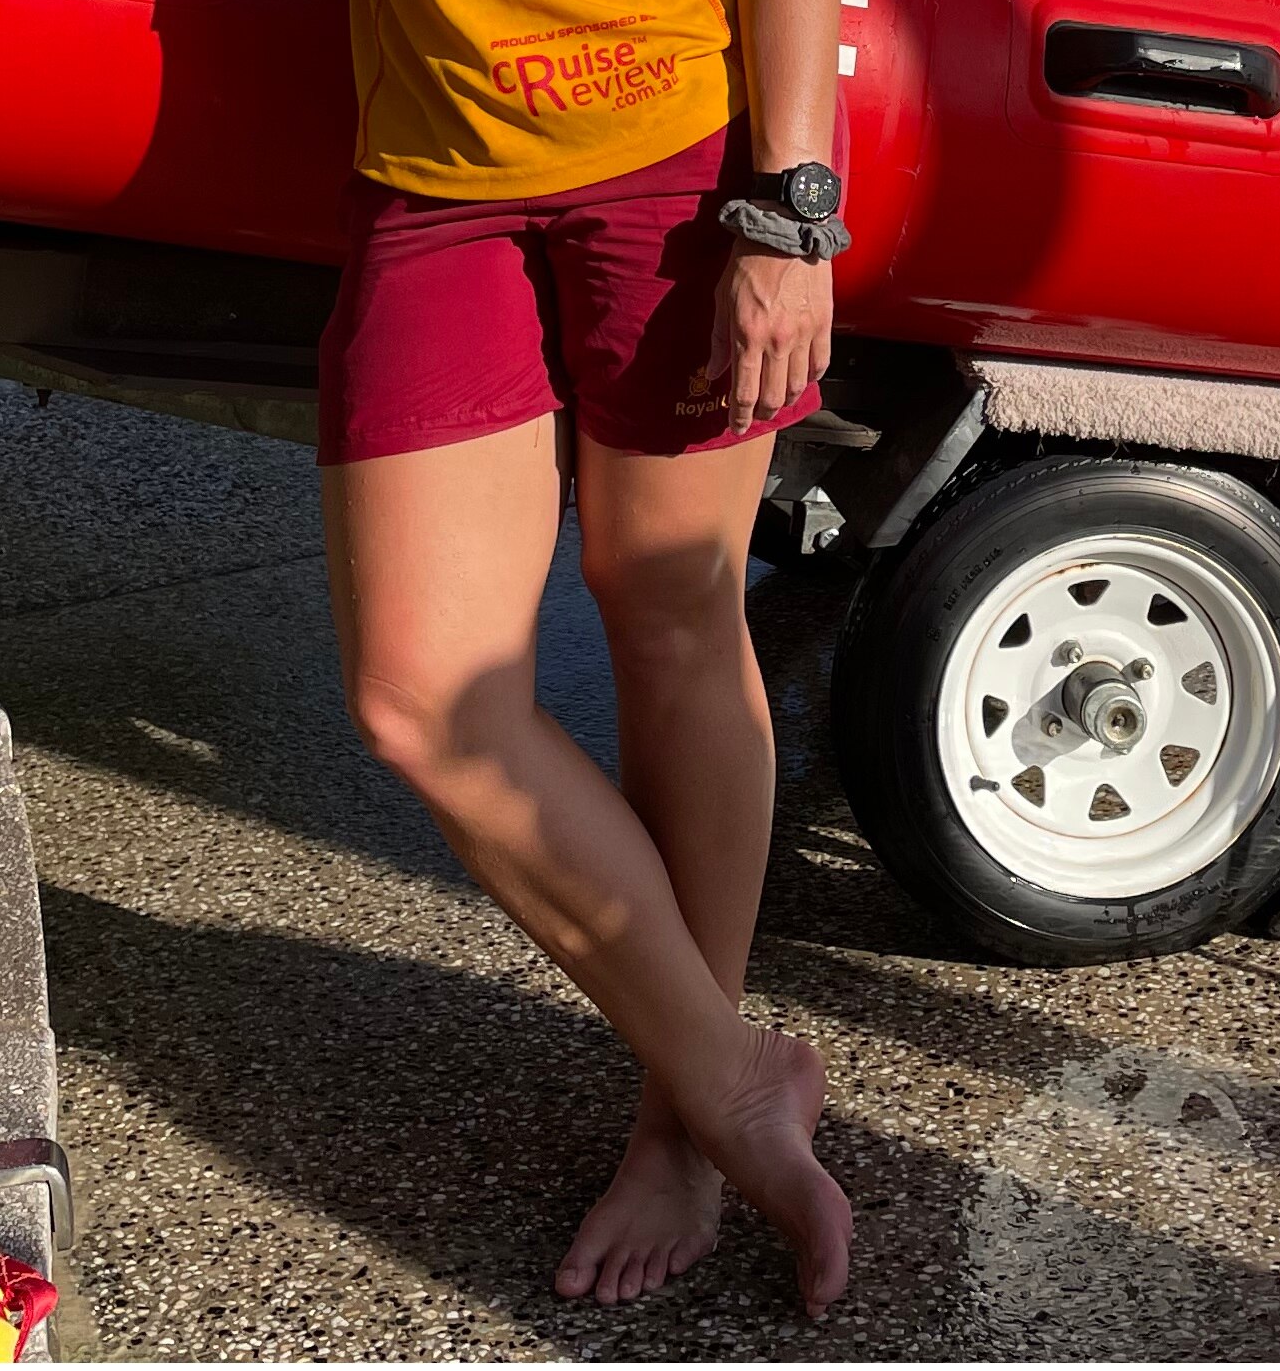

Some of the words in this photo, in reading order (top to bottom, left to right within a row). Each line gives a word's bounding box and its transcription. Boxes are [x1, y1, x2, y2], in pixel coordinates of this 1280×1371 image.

[490, 31, 556, 51] PROUDLY
[557, 15, 638, 39] SPONSORED
[675, 396, 719, 418] Royal
